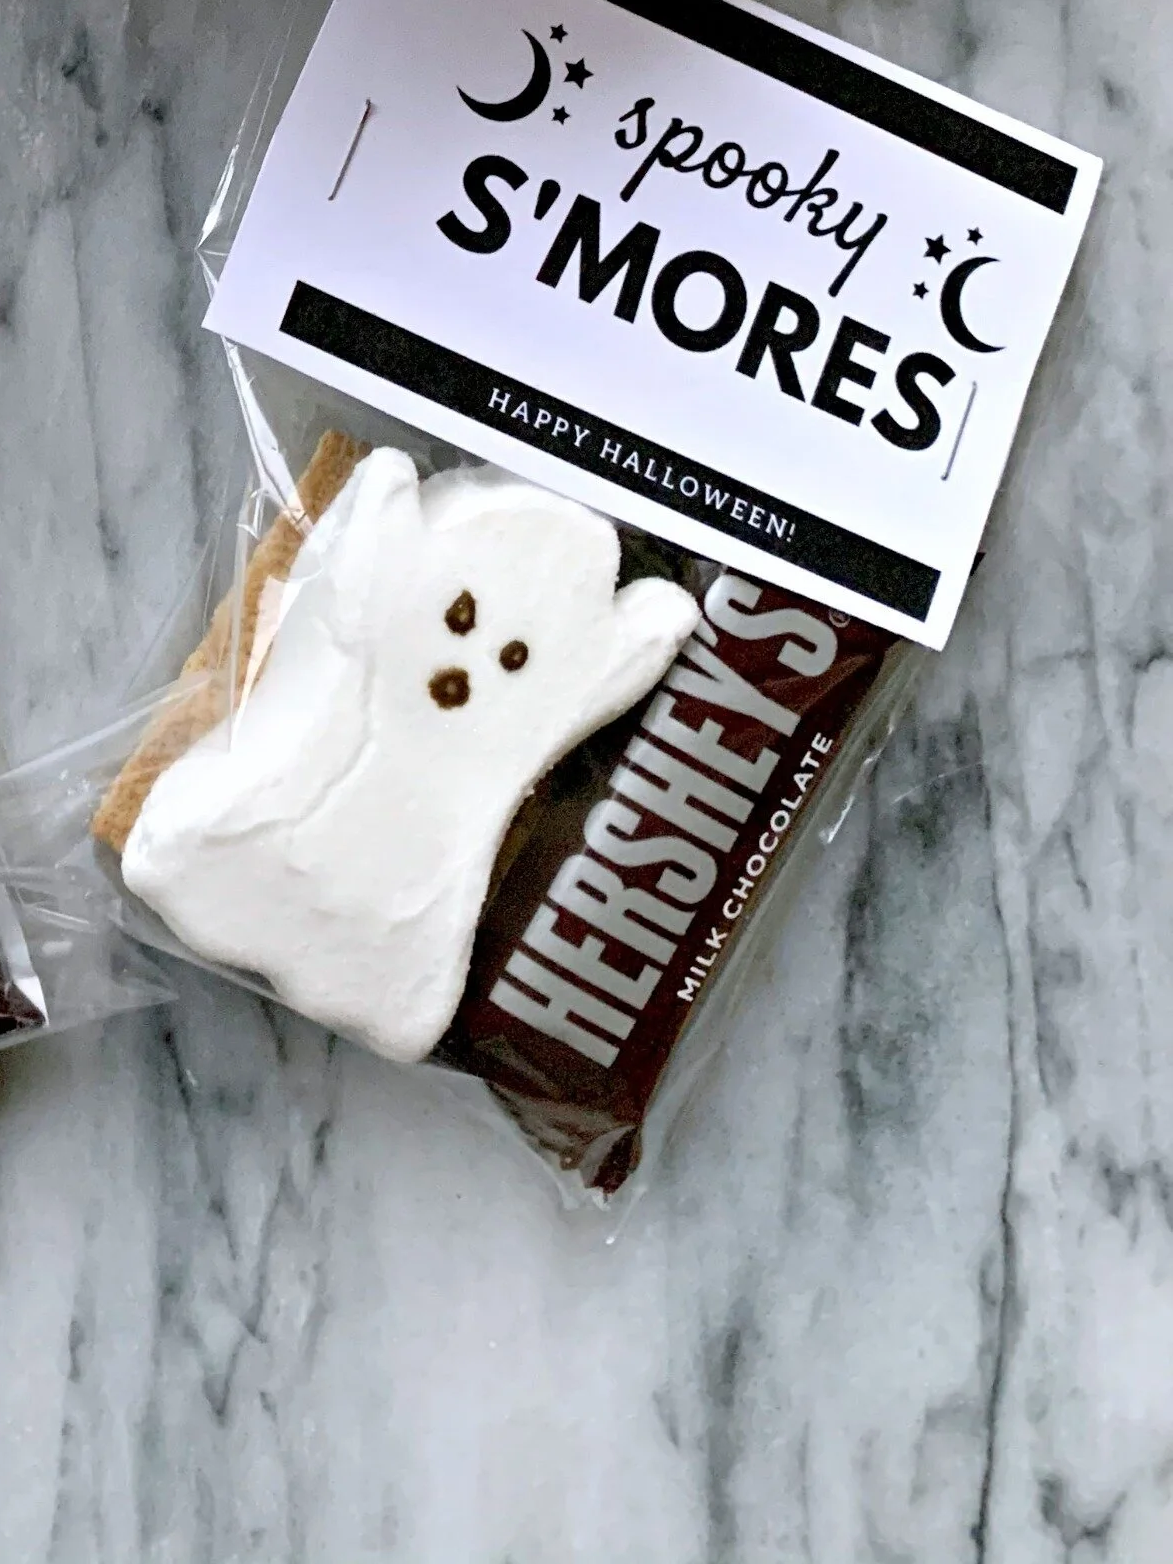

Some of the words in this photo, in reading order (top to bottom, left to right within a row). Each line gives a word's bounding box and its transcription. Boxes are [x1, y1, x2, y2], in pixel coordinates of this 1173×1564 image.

[435, 153, 957, 453] S'MORES
[614, 96, 889, 298] spooky
[488, 388, 591, 448] HAPPY
[599, 438, 796, 543] HALLOWEEN!
[487, 574, 839, 1069] HERSHEY'S
[676, 927, 728, 1003] MILK
[722, 731, 833, 920] CHOCOLATE
